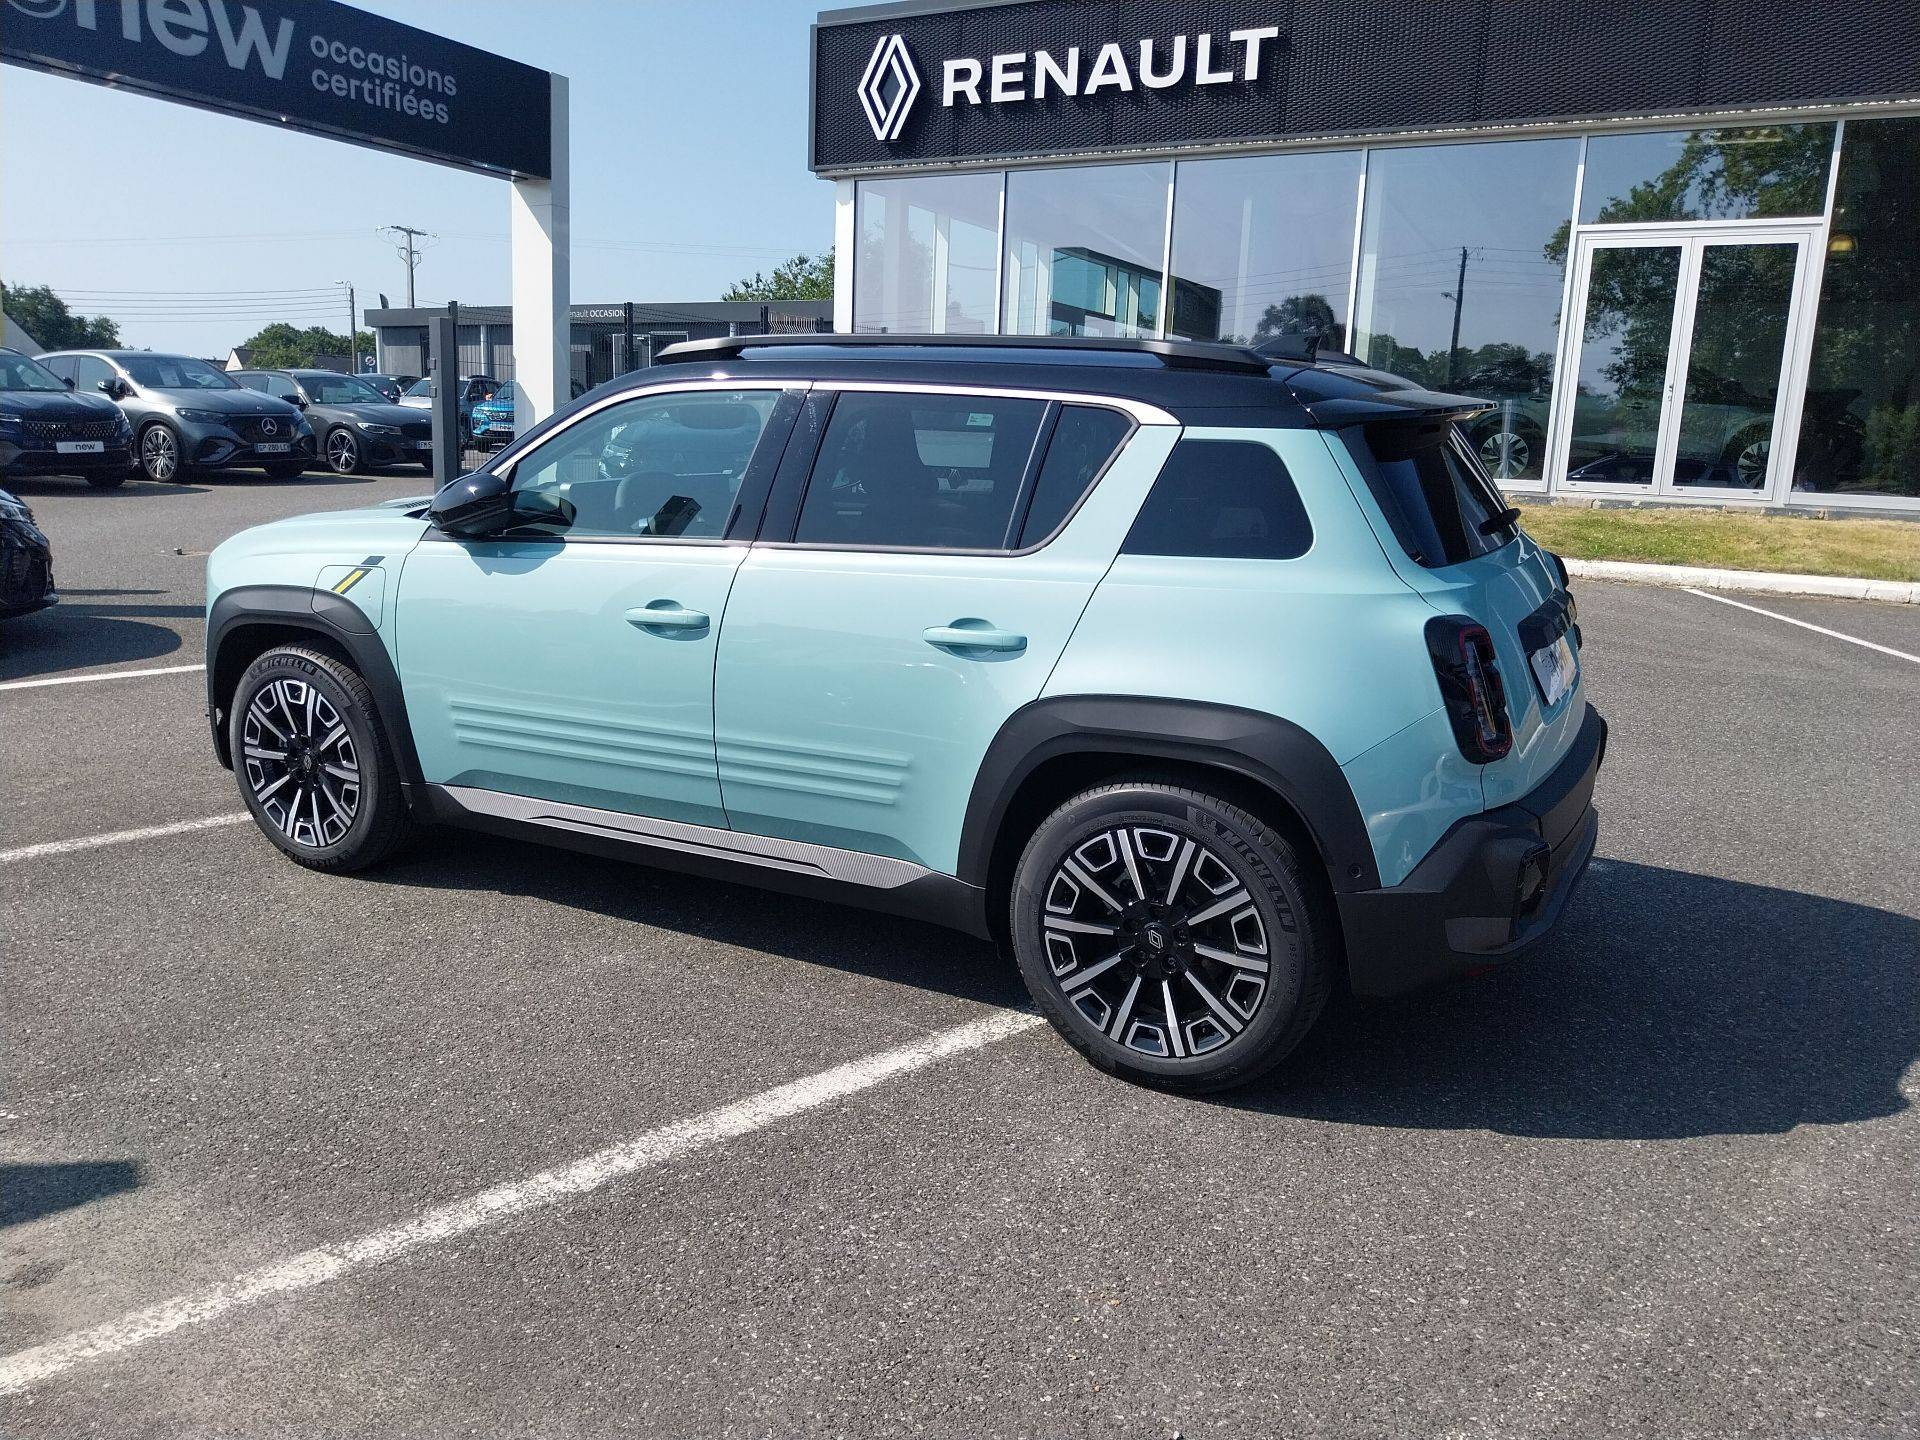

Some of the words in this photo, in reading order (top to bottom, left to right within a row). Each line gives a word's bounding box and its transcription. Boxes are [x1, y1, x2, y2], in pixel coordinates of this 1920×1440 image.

[310, 35, 457, 97] occasions
[942, 26, 1279, 107] RENAULT
[311, 68, 450, 124] certifiées
[570, 310, 589, 318] enault
[75, 443, 96, 451] new
[261, 657, 317, 675] MICHELIN
[1219, 829, 1298, 934] MICHELIN
